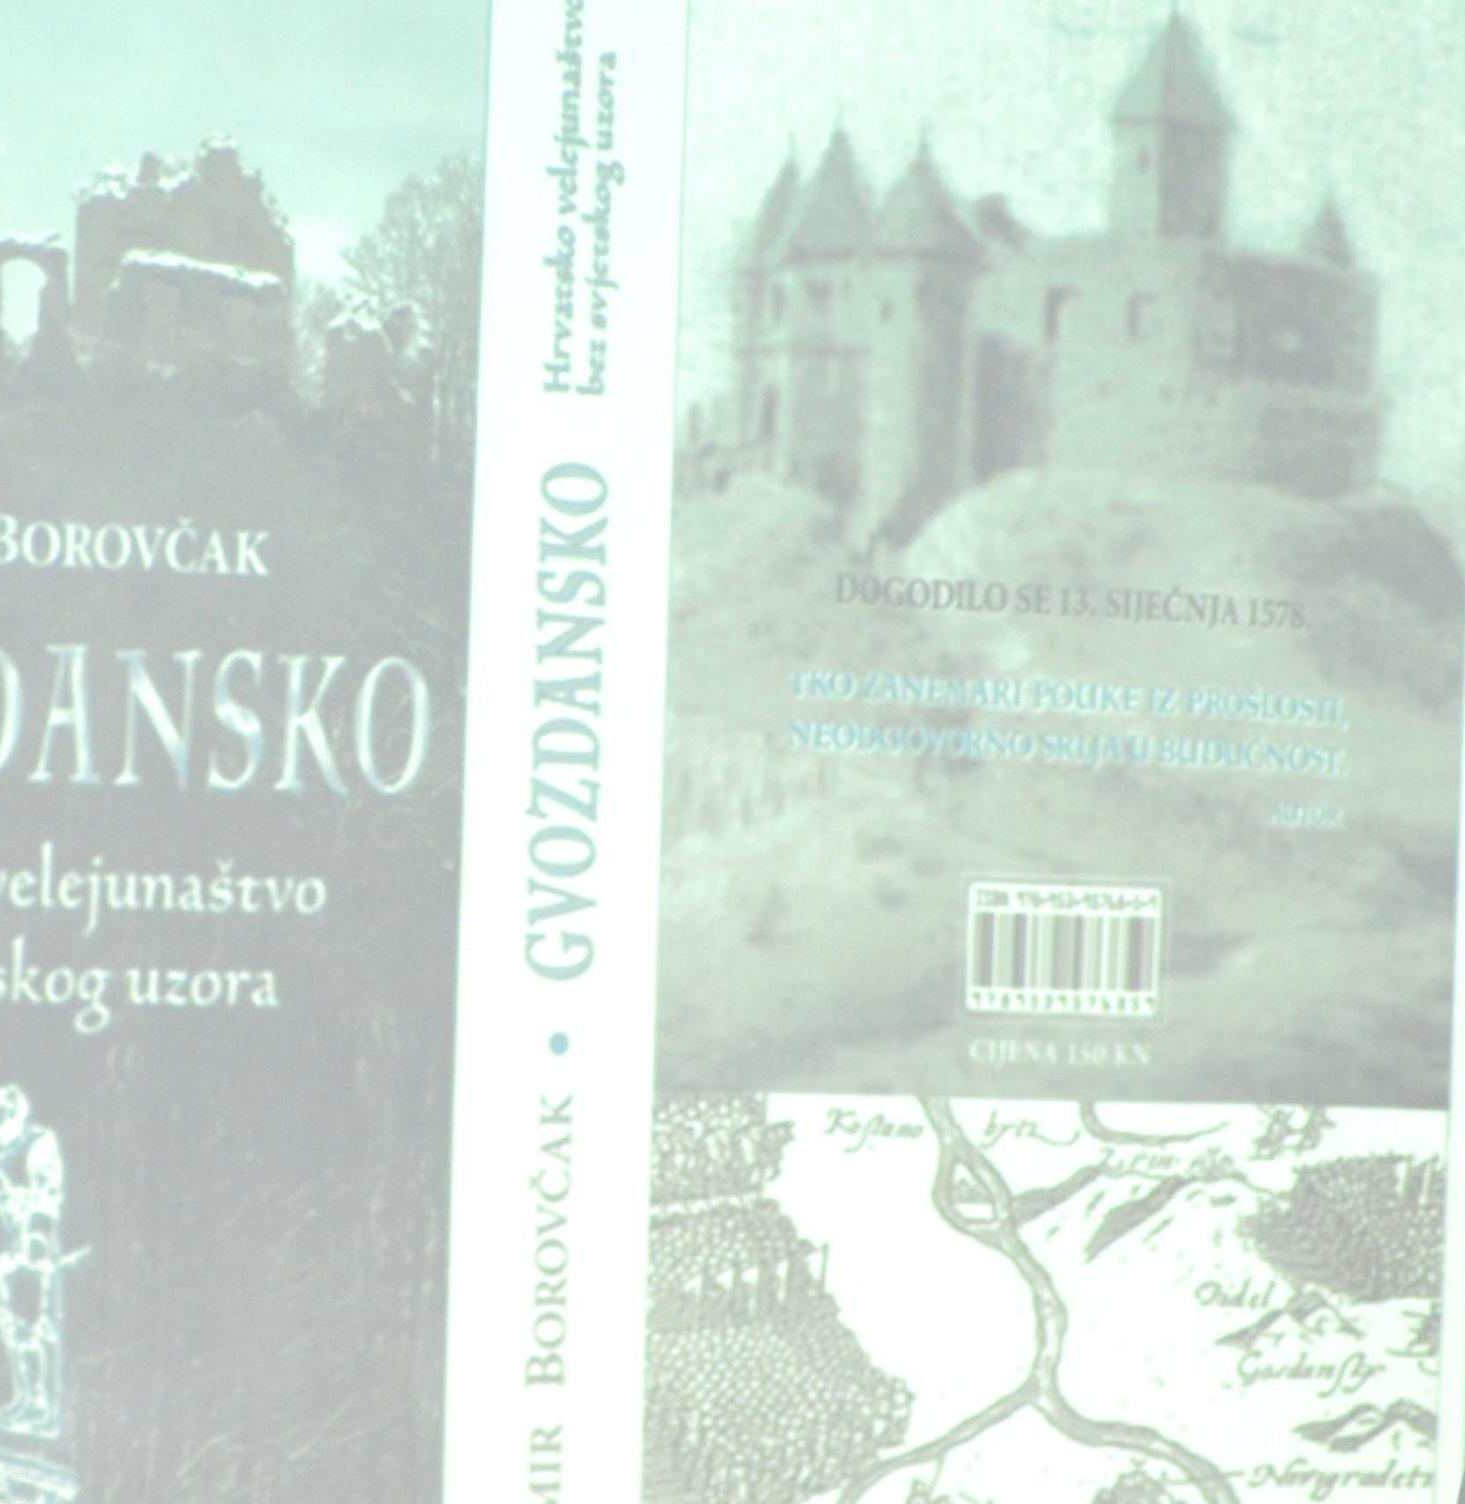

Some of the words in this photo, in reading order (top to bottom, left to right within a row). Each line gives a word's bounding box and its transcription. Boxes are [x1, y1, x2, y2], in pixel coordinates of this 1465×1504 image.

[597, 50, 617, 152] uzora
[543, 226, 577, 393] Hrvatsko
[582, 158, 626, 331] svjetskog
[576, 338, 606, 396] bez
[835, 572, 1009, 614] DOGODILO
[1015, 582, 1050, 615] SE
[524, 461, 609, 982] GVOZDANSKO
[130, 967, 279, 1007] uzora
[525, 1092, 574, 1388] BOROVČAK
